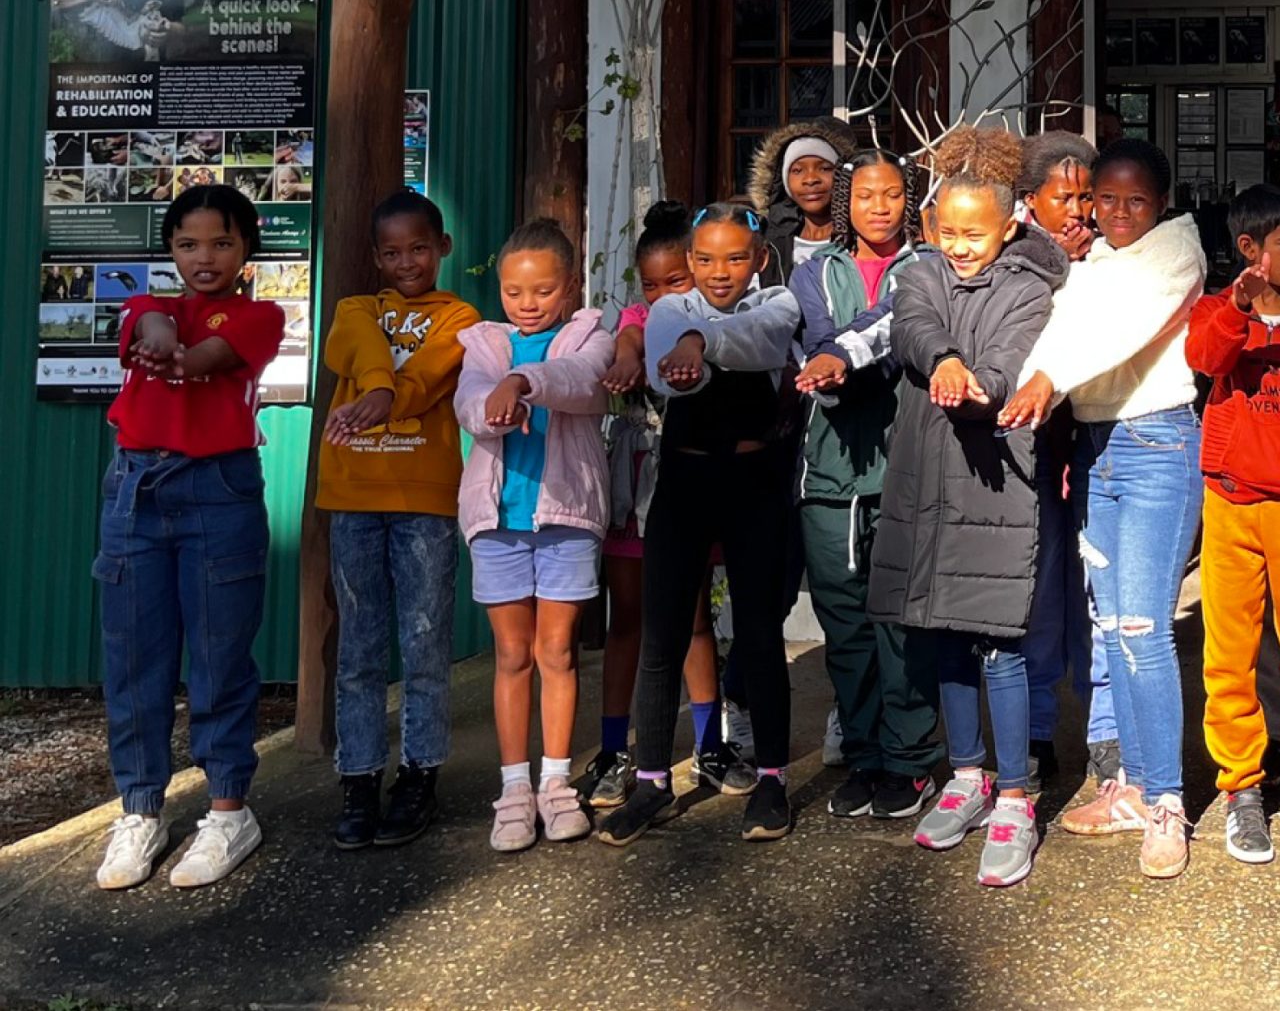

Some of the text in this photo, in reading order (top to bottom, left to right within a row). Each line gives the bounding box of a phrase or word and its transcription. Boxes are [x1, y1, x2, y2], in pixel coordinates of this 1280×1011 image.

[209, 17, 292, 35] behind the
[221, 35, 278, 53] scenes!
[57, 73, 154, 84] THE IMPORTANCE OF
[56, 89, 154, 100] REHABILITATION
[56, 104, 152, 117] & EDUCATION
